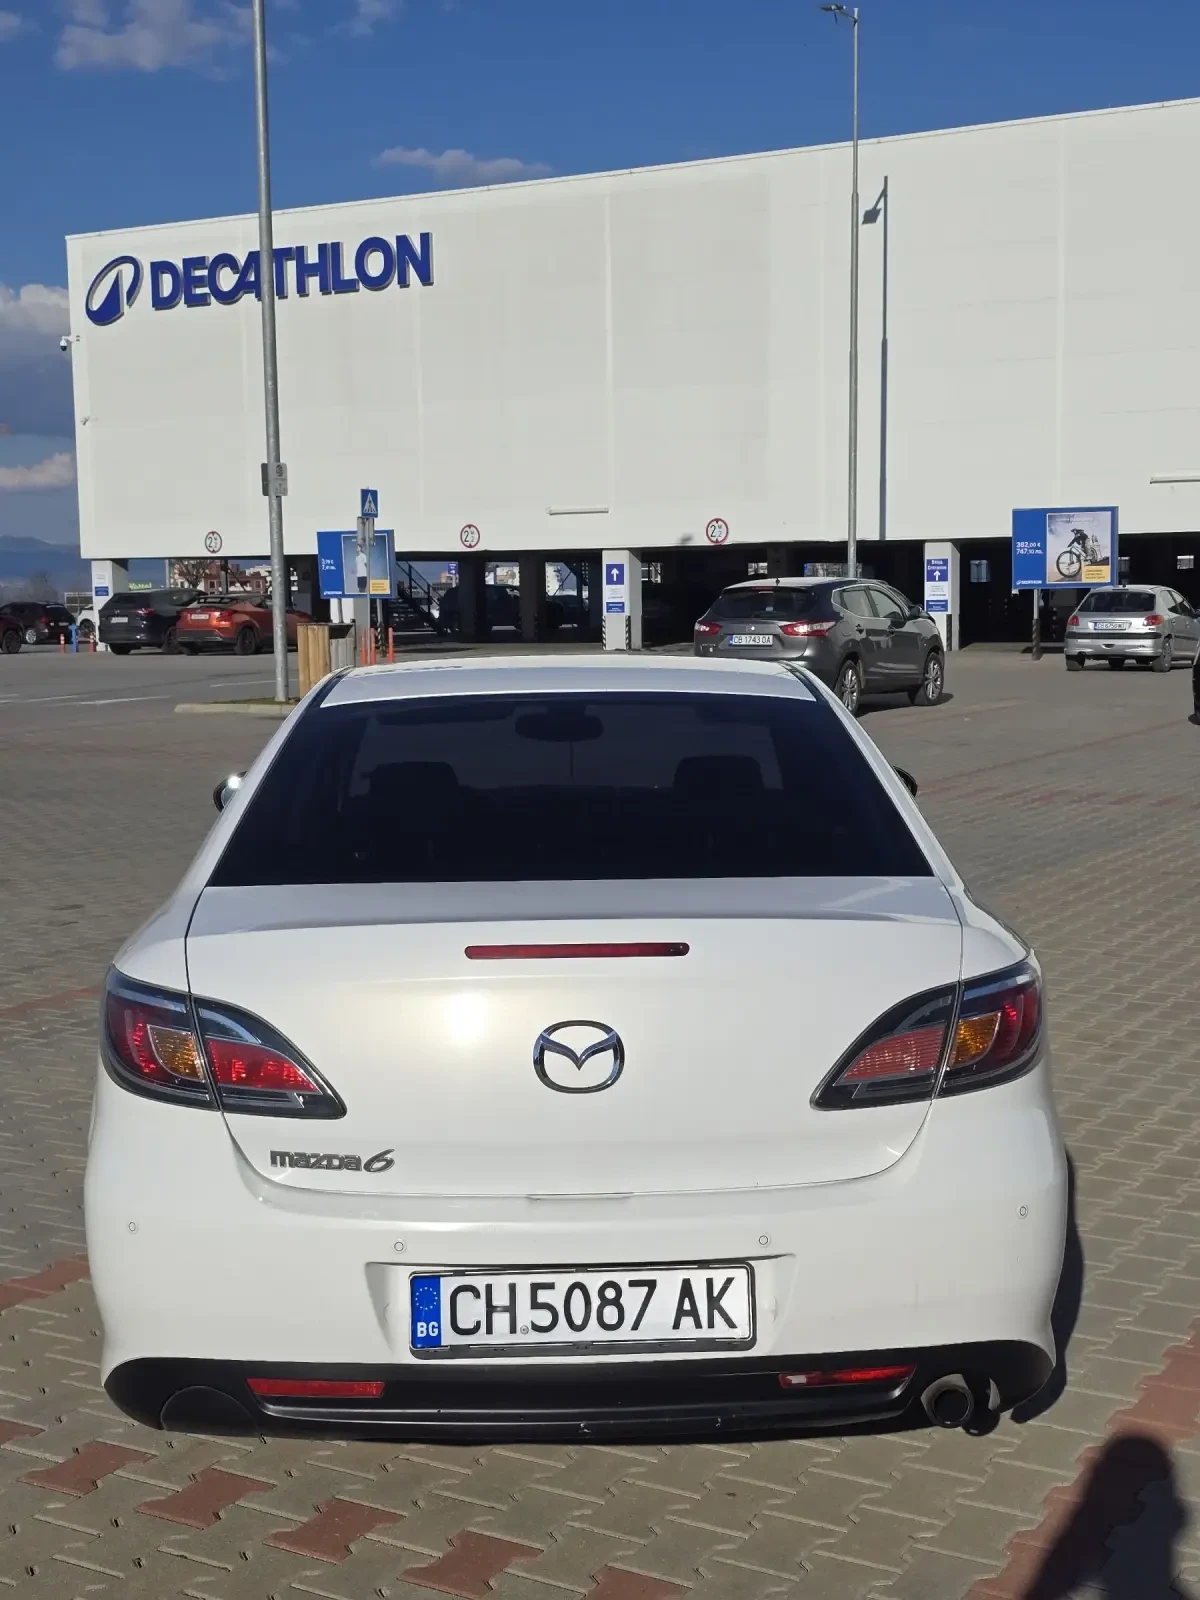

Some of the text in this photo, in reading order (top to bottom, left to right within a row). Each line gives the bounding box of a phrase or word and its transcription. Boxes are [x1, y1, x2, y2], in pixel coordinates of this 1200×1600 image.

[150, 232, 433, 310] DECATHLON
[733, 636, 742, 644] CB
[744, 636, 760, 644] 1743
[449, 1277, 738, 1336] CH 5087 AK
[416, 1321, 439, 1337] BG
